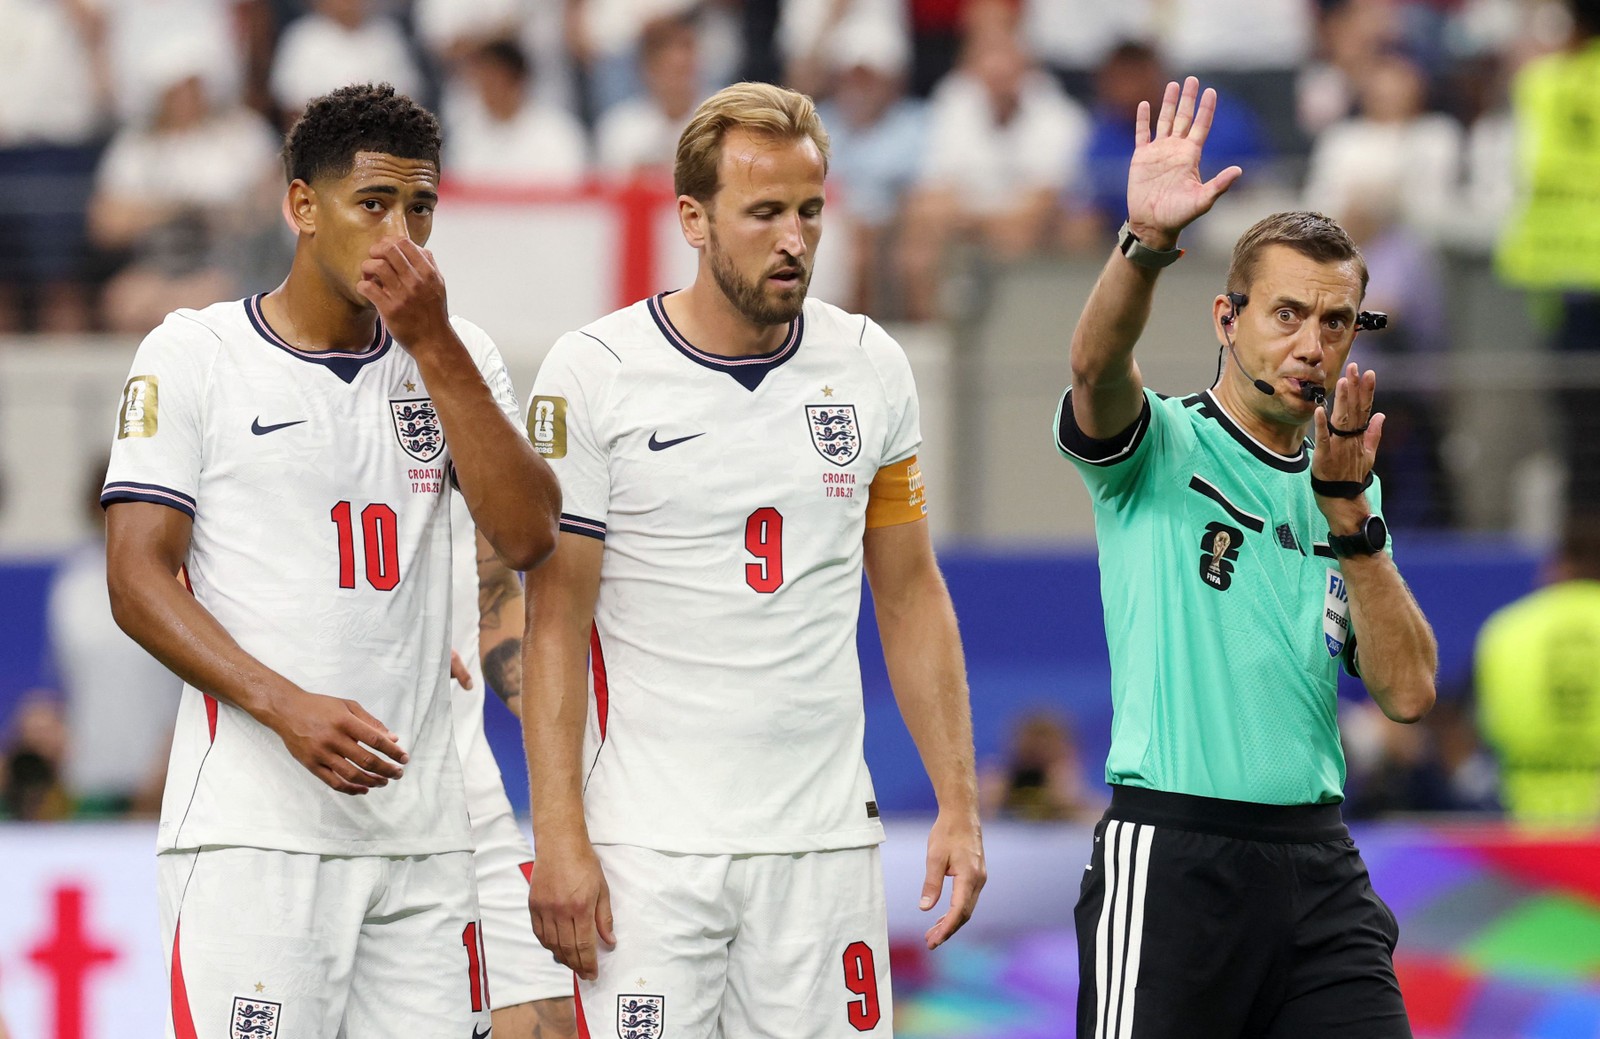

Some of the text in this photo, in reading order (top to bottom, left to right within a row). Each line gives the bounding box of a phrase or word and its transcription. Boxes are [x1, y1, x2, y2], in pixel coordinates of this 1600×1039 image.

[408, 469, 442, 480] CROATIA
[822, 473, 856, 485] CROATIA
[826, 487, 853, 498] 17.06.26
[330, 500, 401, 592] 10
[744, 507, 784, 594] 9
[1206, 572, 1221, 585] FIFA
[1329, 574, 1349, 604] FIF
[1325, 607, 1348, 630] REFEREE
[842, 940, 881, 1032] 9
